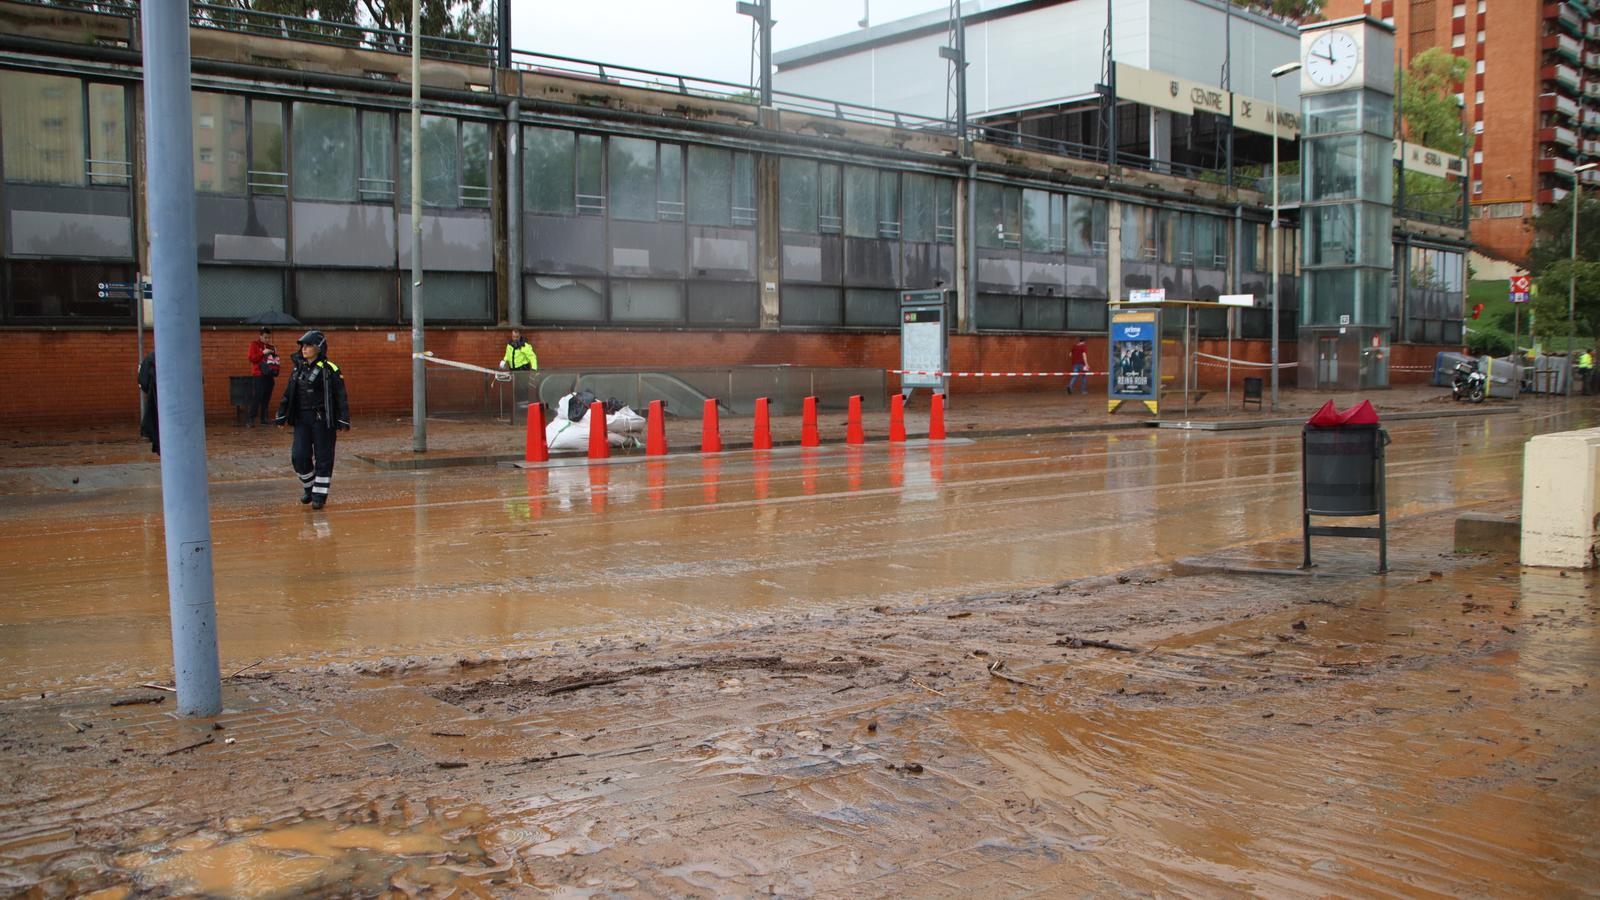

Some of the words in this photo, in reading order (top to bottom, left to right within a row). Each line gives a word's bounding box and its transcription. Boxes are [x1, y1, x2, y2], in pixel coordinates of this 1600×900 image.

[1190, 87, 1222, 111] CENTRE
[1241, 100, 1252, 118] DE
[1124, 326, 1141, 335] prime
